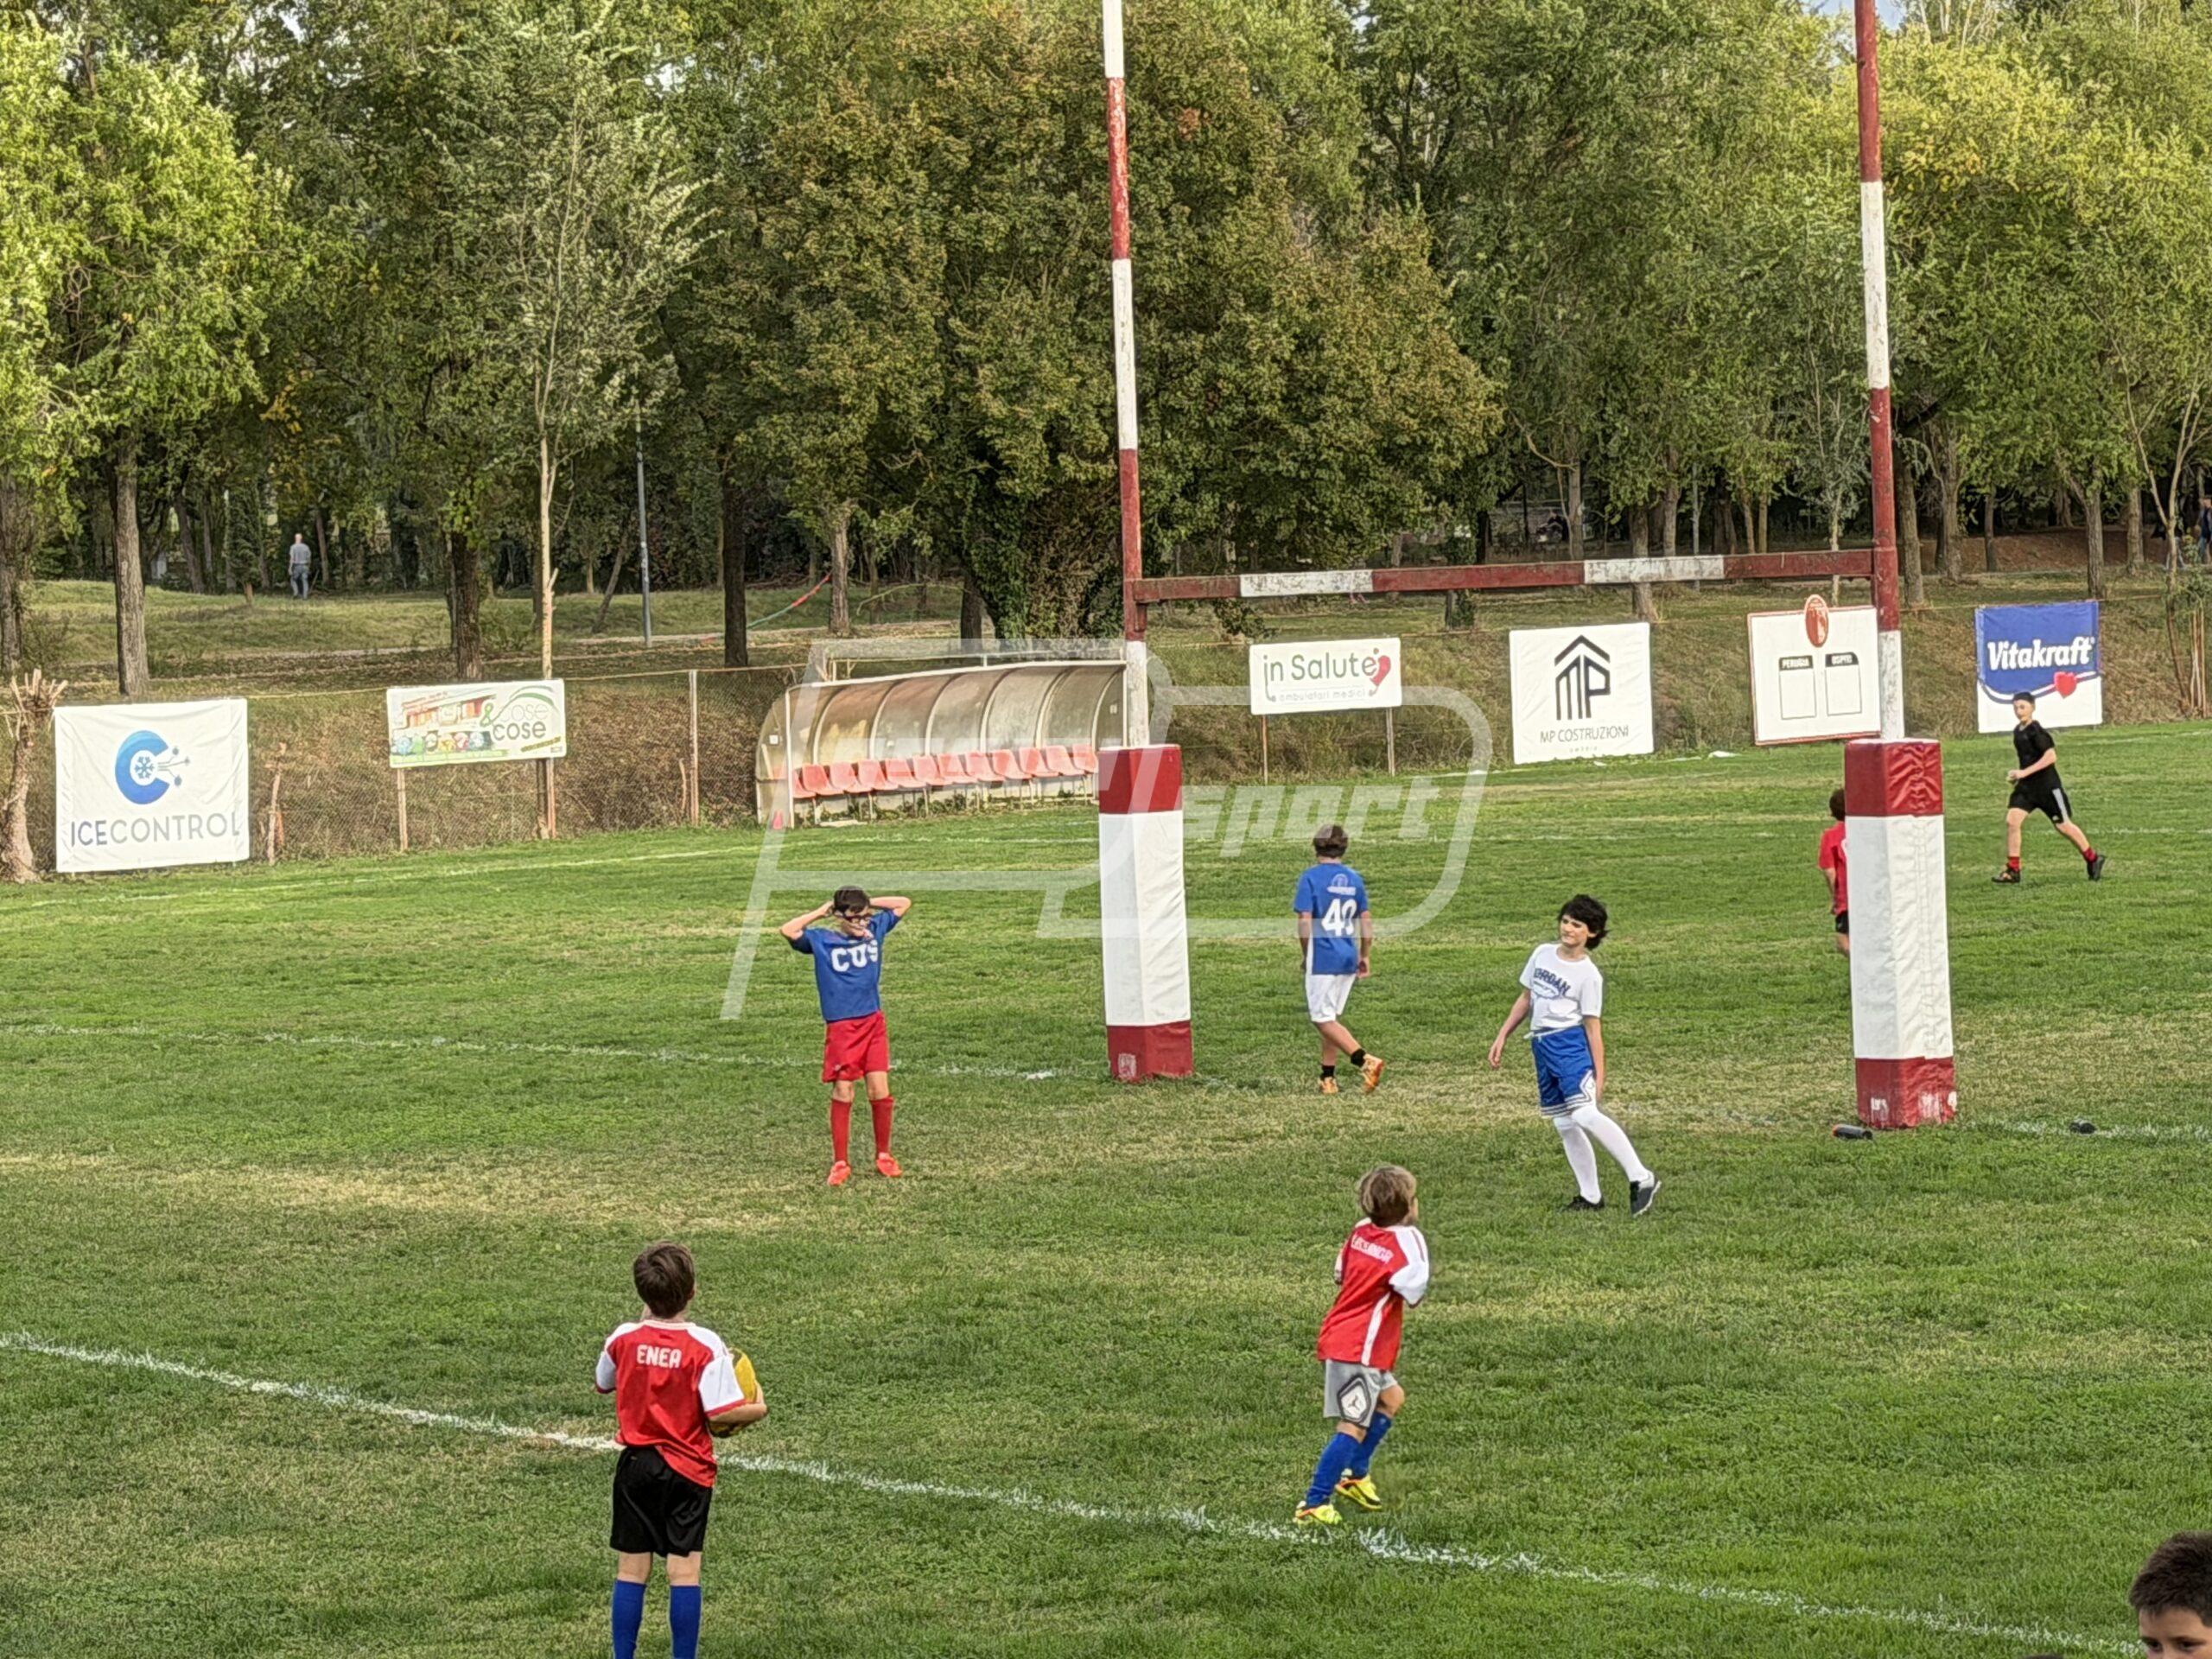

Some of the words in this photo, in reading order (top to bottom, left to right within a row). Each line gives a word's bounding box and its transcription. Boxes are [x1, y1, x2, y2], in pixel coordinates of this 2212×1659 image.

[1291, 652, 1377, 681] Salute
[1986, 636, 2093, 671] Vitakraft
[493, 720, 546, 741] cose
[1541, 730, 1556, 744] MP
[1558, 724, 1630, 743] COSTRUZIONI
[71, 811, 240, 848] ICECONTROL
